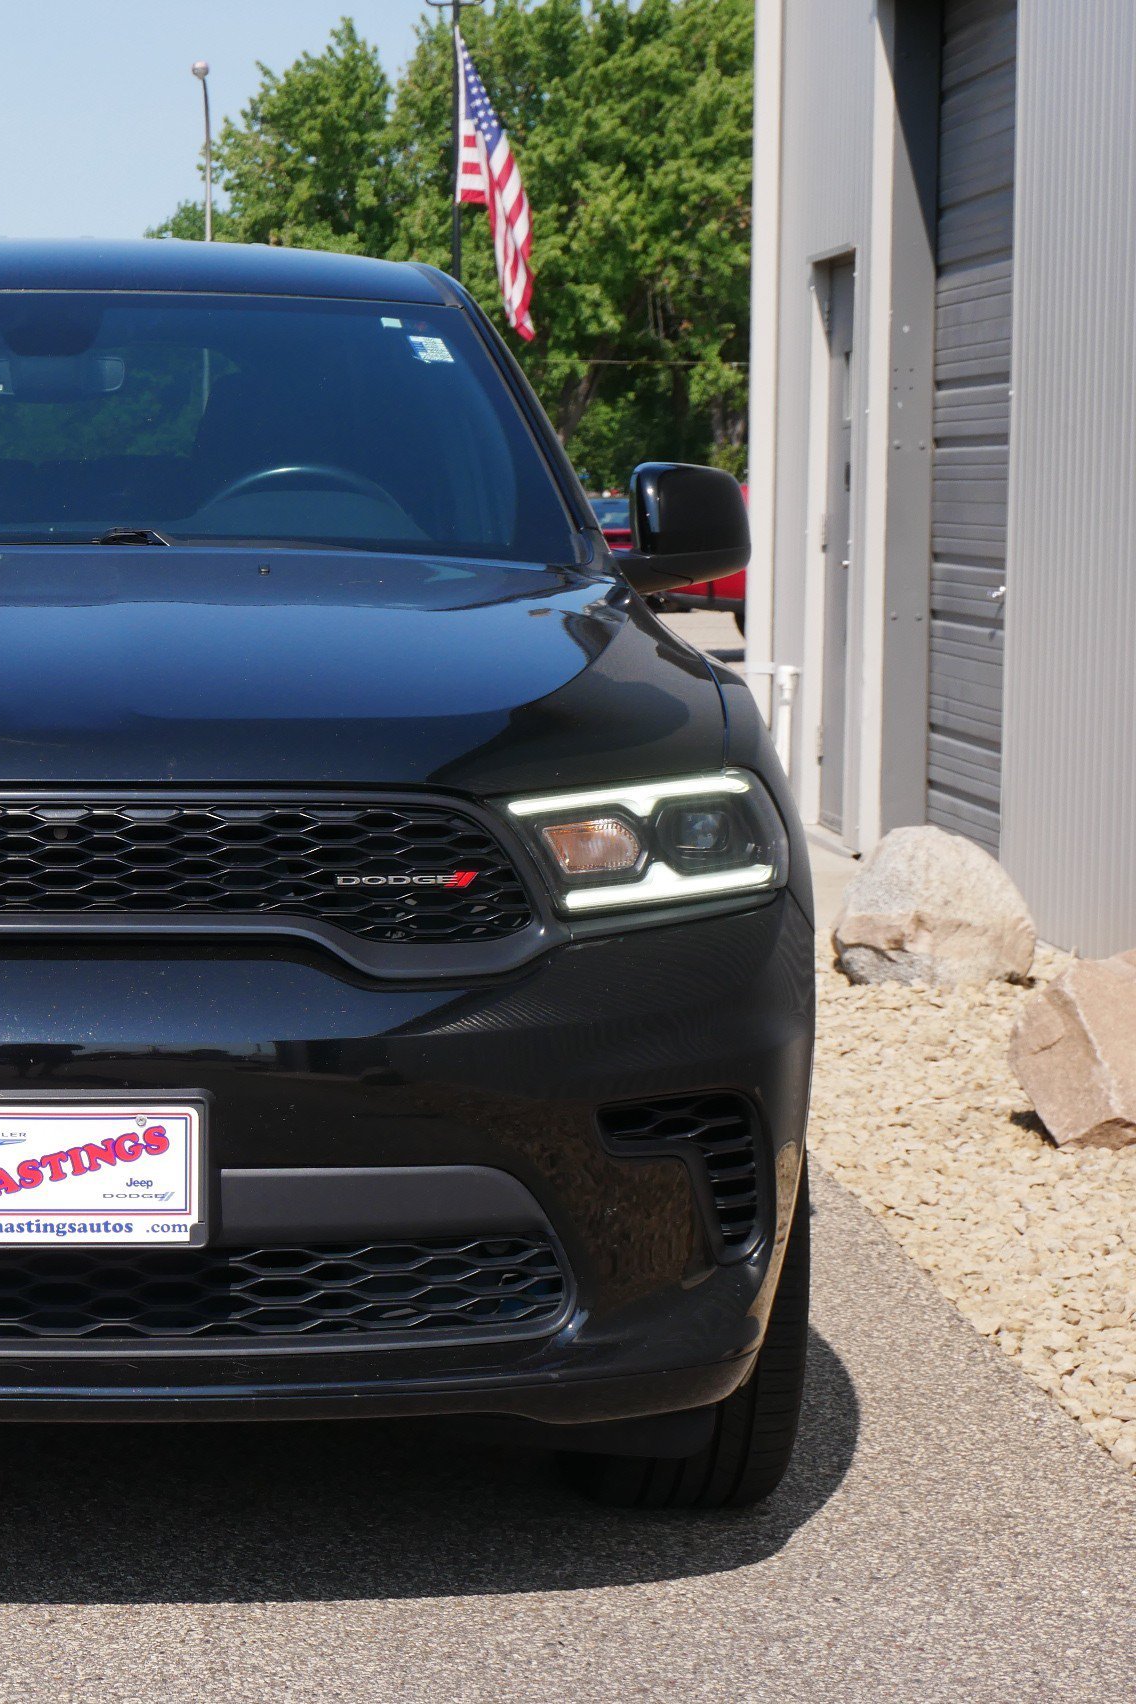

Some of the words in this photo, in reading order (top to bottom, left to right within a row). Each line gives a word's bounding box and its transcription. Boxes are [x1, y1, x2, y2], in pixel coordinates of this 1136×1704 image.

[337, 875, 459, 886] DODGE
[126, 1177, 154, 1189] Jeep
[146, 1222, 189, 1233] .com
